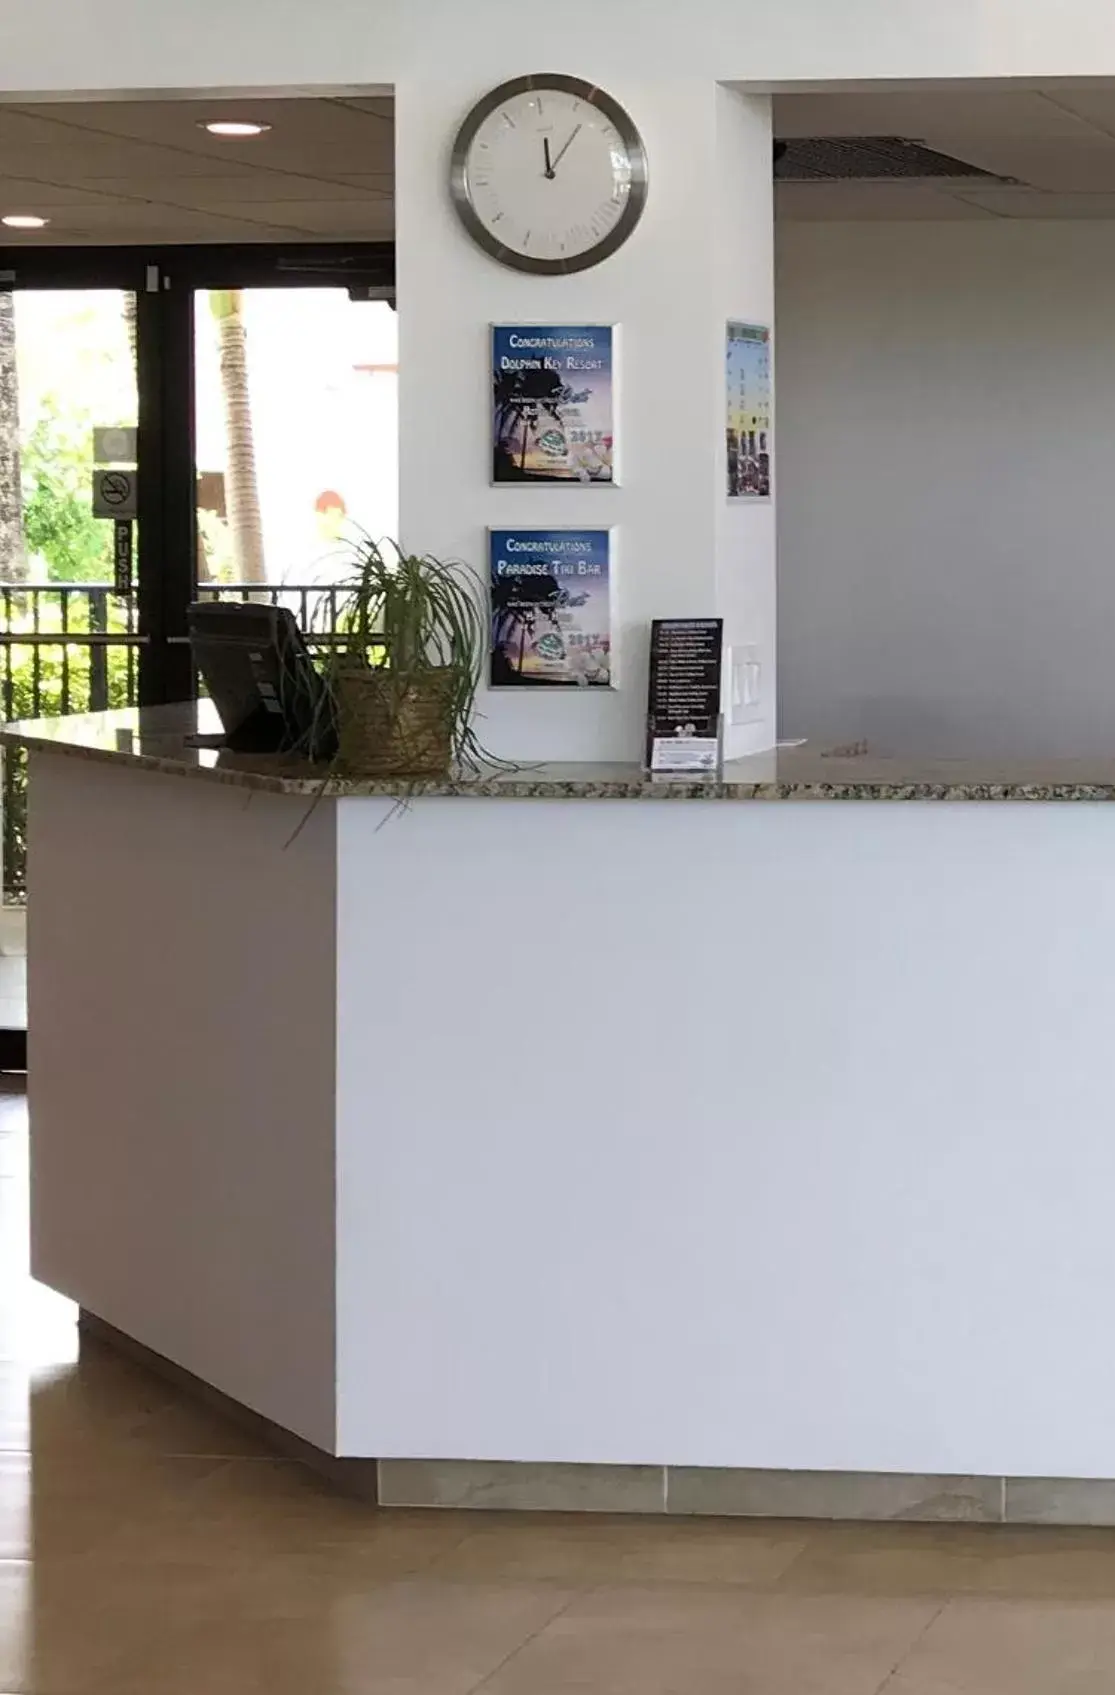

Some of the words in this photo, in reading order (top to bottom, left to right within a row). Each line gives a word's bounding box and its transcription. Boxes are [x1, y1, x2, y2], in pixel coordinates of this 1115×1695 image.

[544, 356, 563, 370] KEY
[566, 356, 602, 370] RESORT
[117, 526, 129, 589] PUSH
[578, 560, 602, 575] BAR
